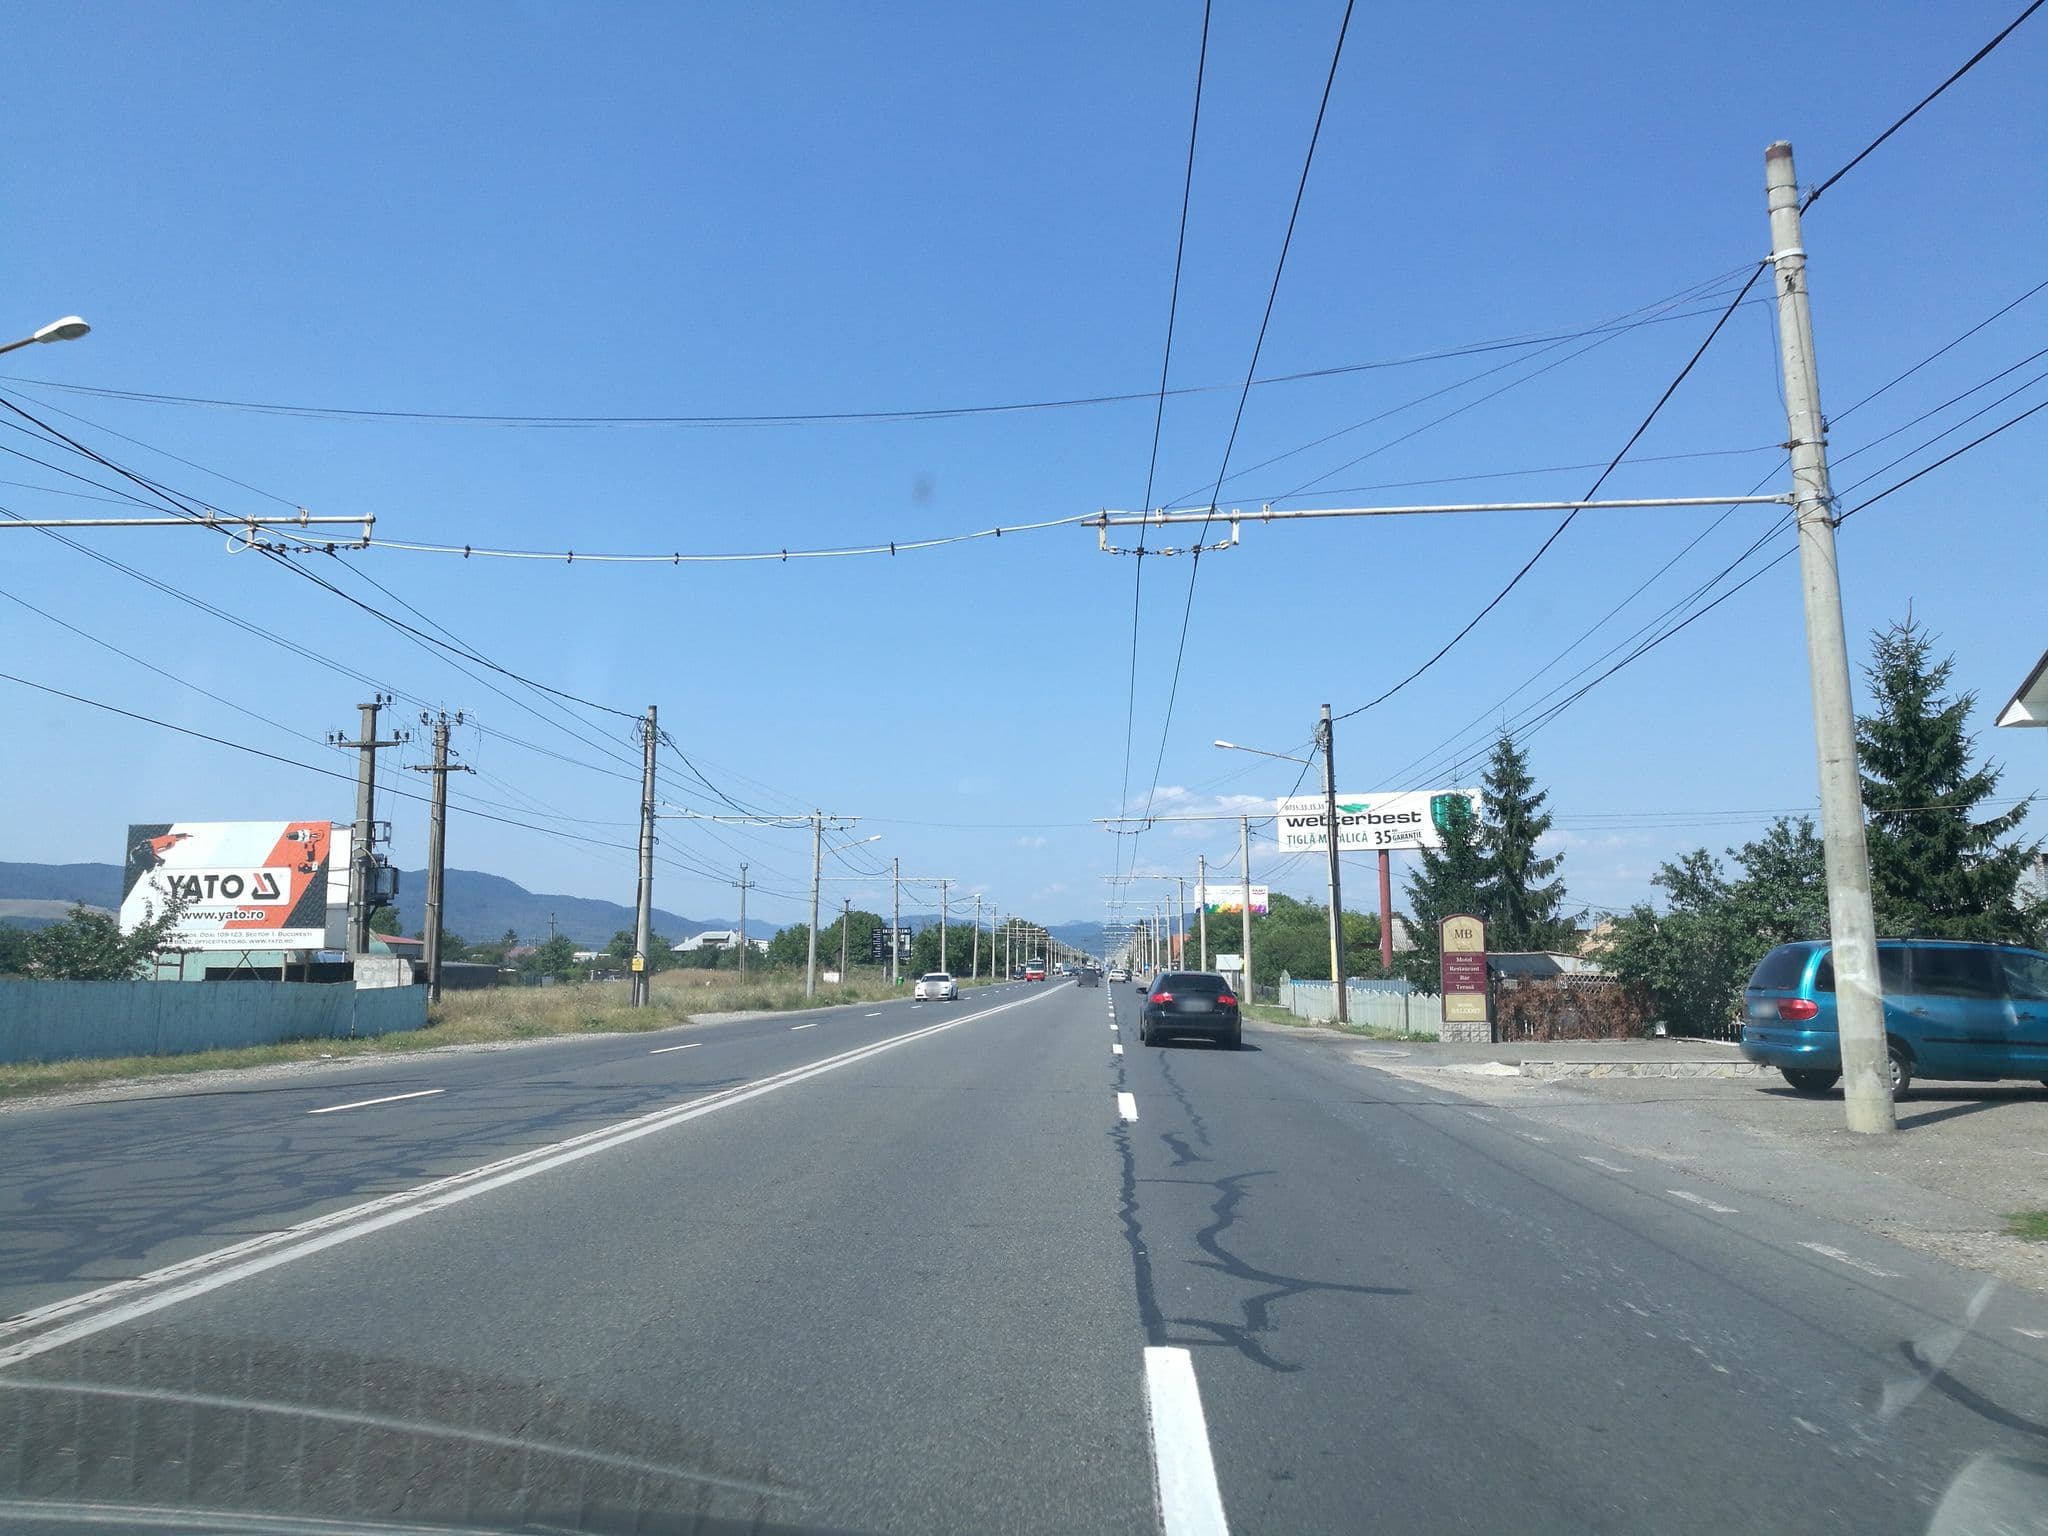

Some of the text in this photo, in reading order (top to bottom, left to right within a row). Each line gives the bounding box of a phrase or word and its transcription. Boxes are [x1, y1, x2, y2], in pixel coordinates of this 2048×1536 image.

[1318, 830, 1368, 844] MALICĂ
[1375, 829, 1392, 845] 35
[167, 874, 244, 900] YATO
[181, 910, 264, 922] www.yato.ro
[1454, 928, 1473, 939] MB
